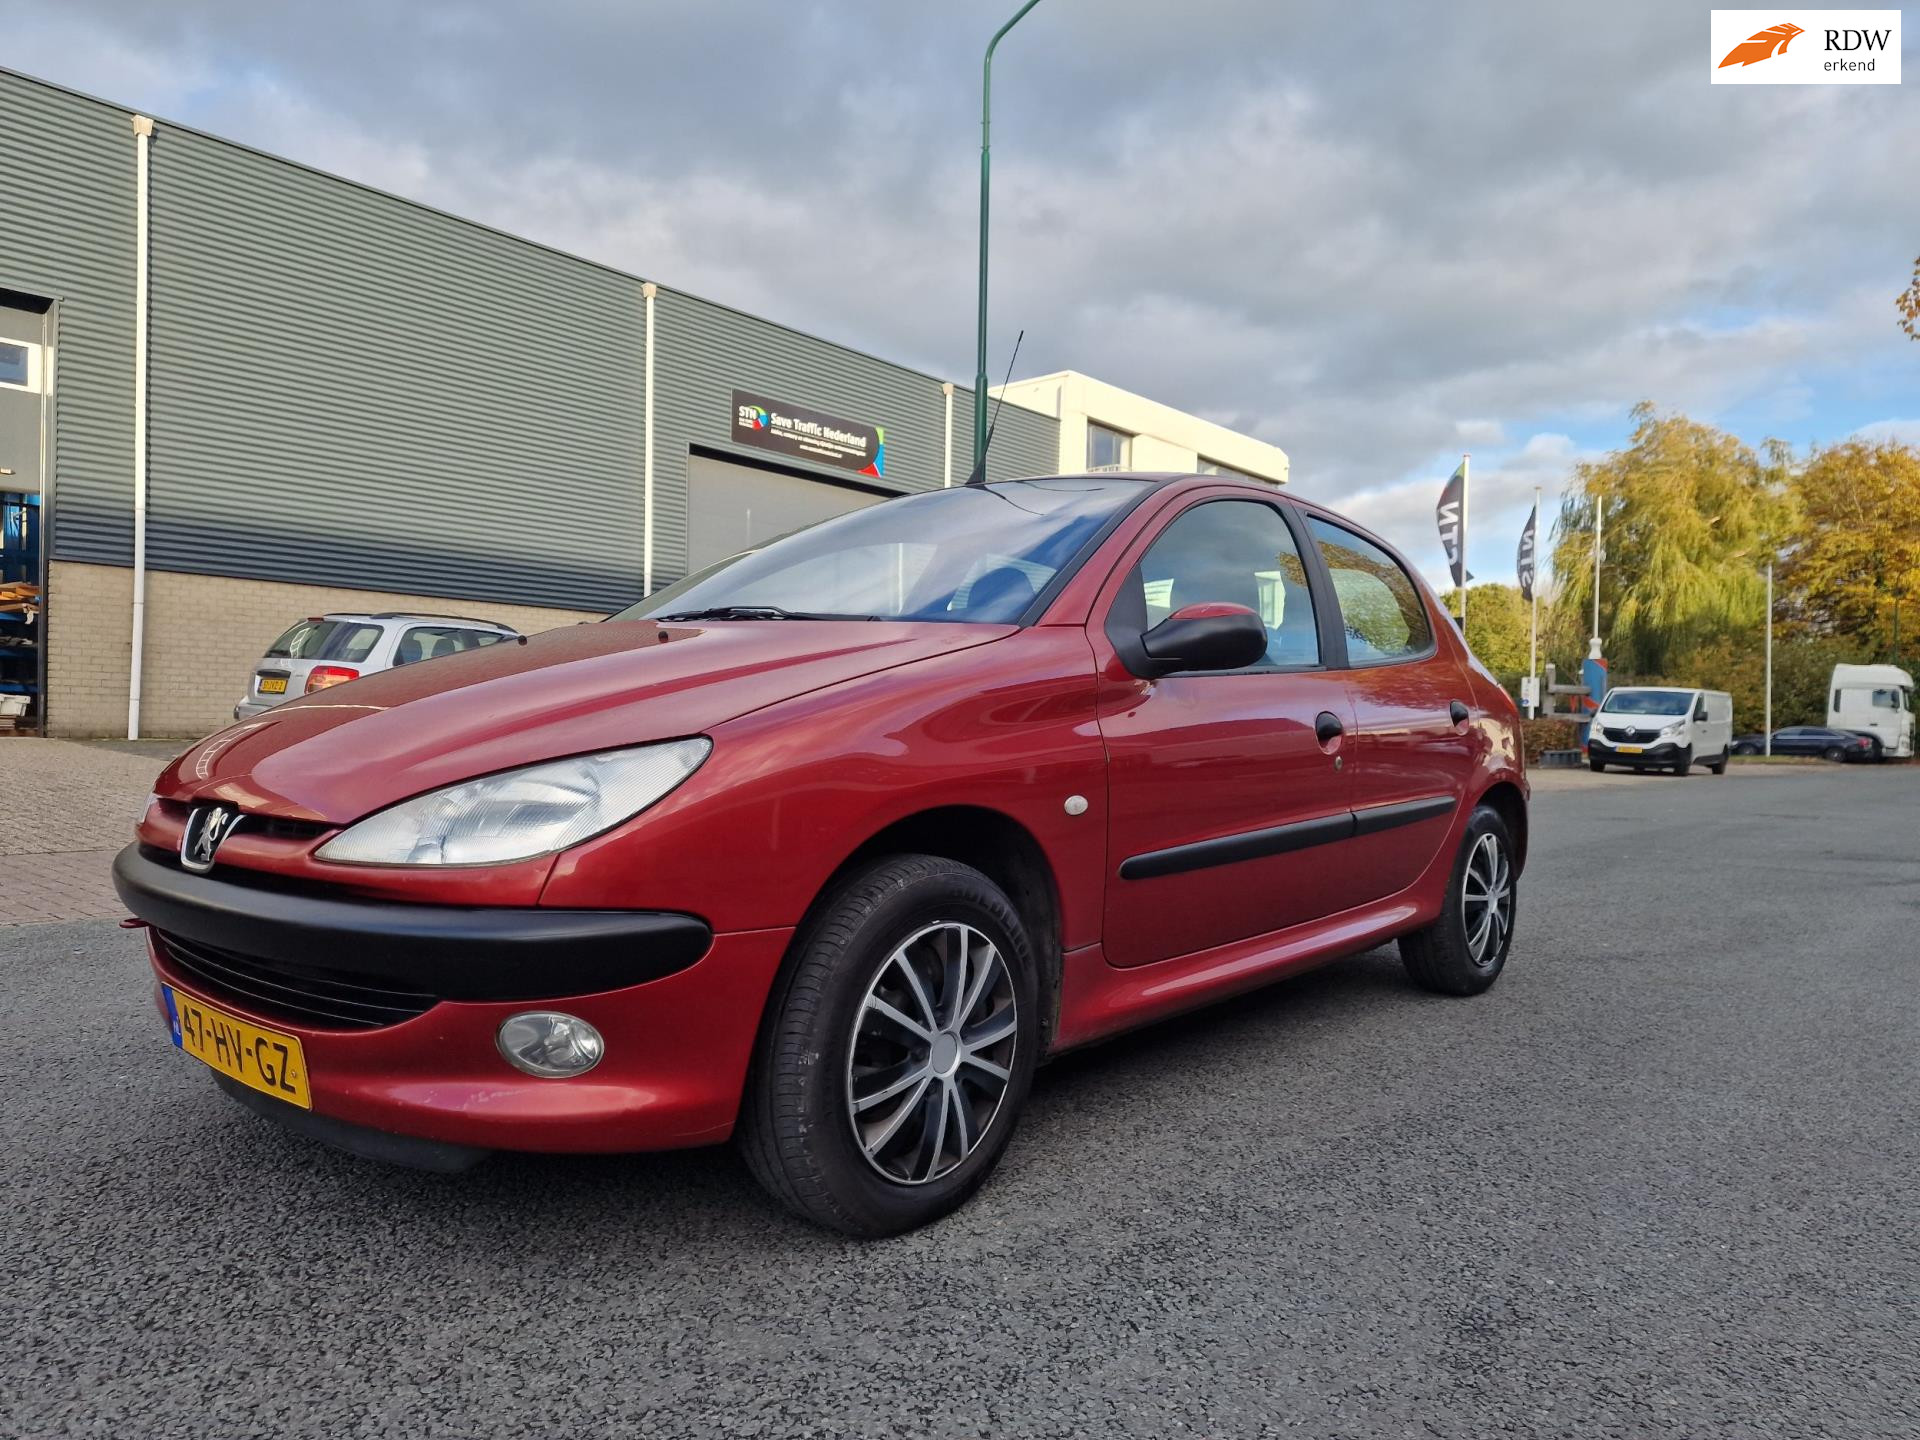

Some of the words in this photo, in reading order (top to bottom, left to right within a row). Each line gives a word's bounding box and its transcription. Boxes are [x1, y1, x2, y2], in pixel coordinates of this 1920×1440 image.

[738, 405, 757, 420] STN
[770, 412, 792, 429] Save
[793, 418, 823, 437] Traffic
[823, 426, 867, 448] Nederland
[183, 1004, 297, 1095] 47-HV-GZ
